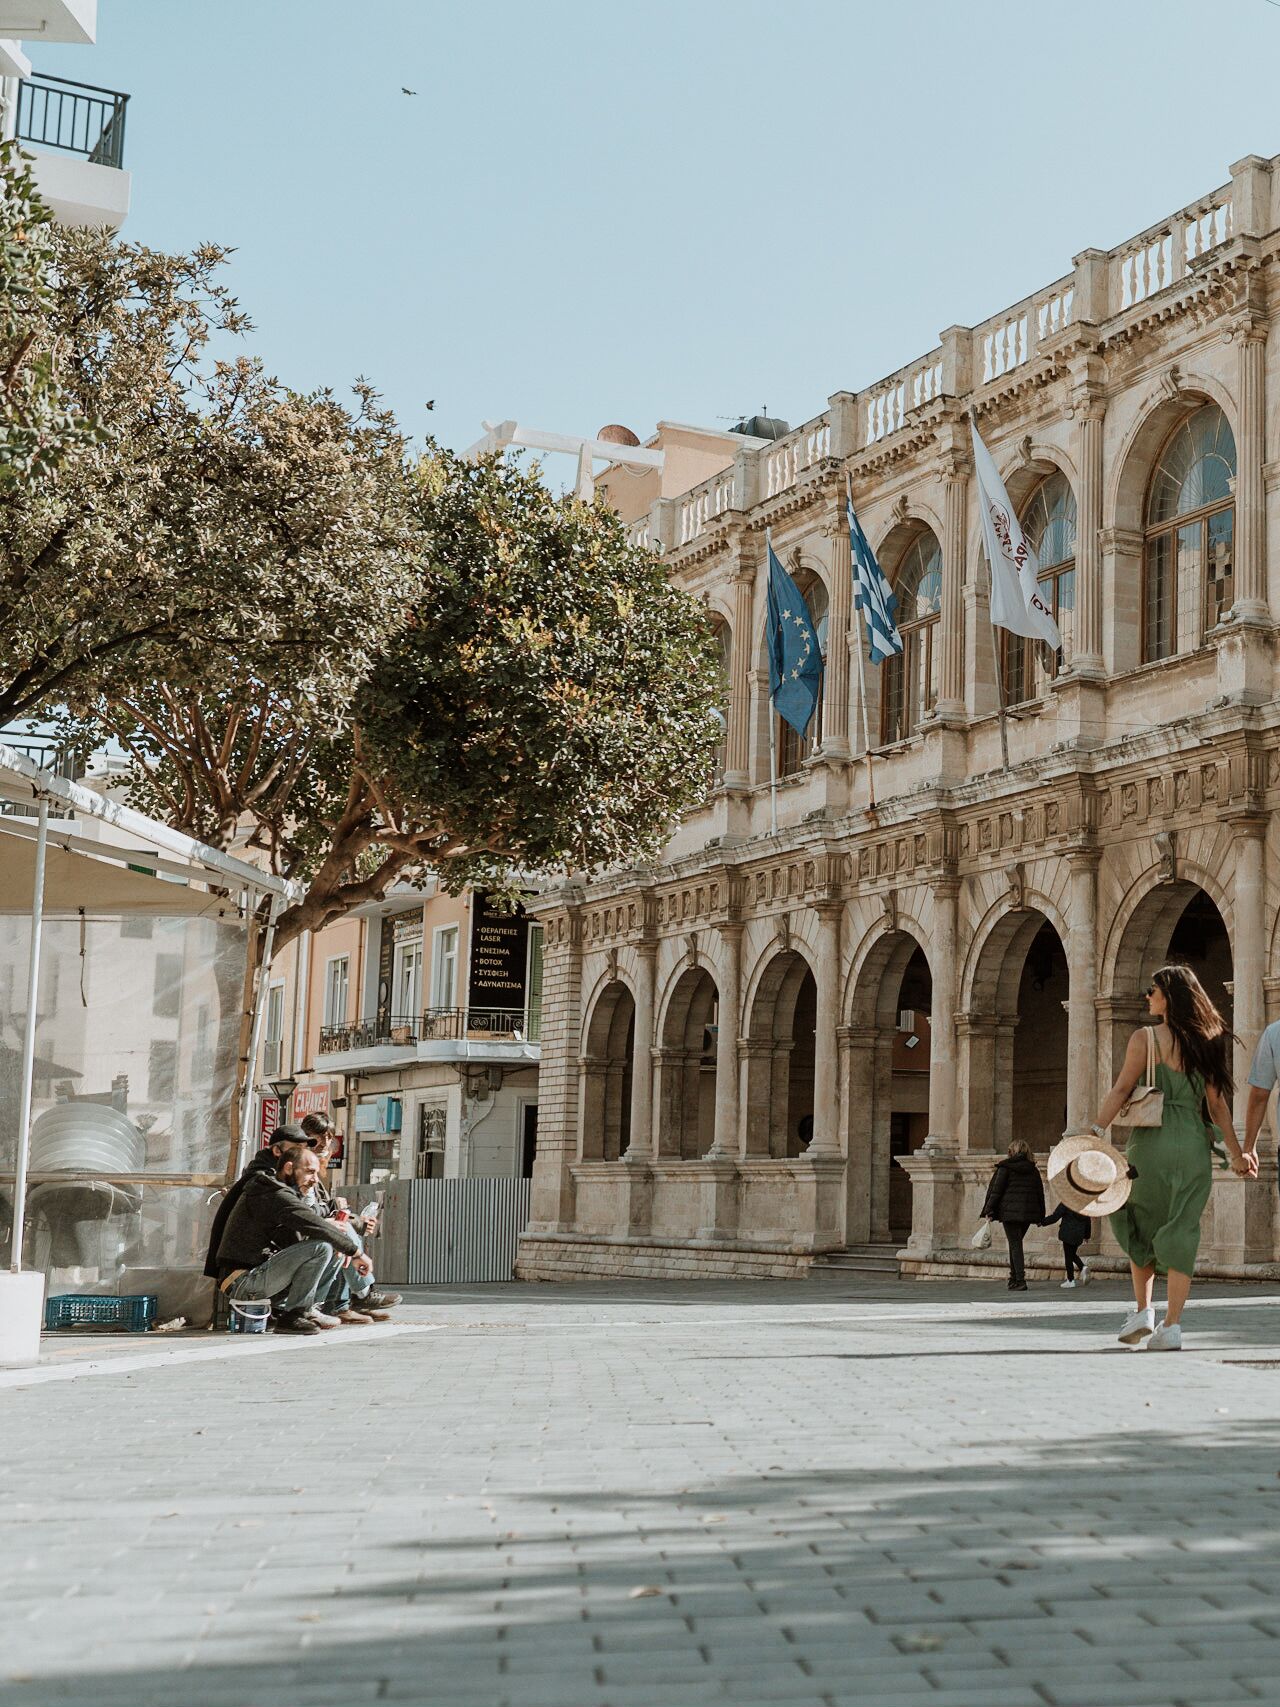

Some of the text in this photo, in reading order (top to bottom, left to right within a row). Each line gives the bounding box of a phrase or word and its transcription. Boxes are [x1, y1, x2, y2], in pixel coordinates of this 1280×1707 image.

[481, 927, 518, 935] ΘΕΡΑΠΕΙΕΣ
[480, 947, 510, 955] ΕΝΕΣΙΜΑ
[479, 969, 509, 977] ΣΥΣΦΙΞΗ
[478, 981, 522, 989] ΑΔΥΝΑΤΙΣΜΑ
[295, 1089, 328, 1113] CARAVEL
